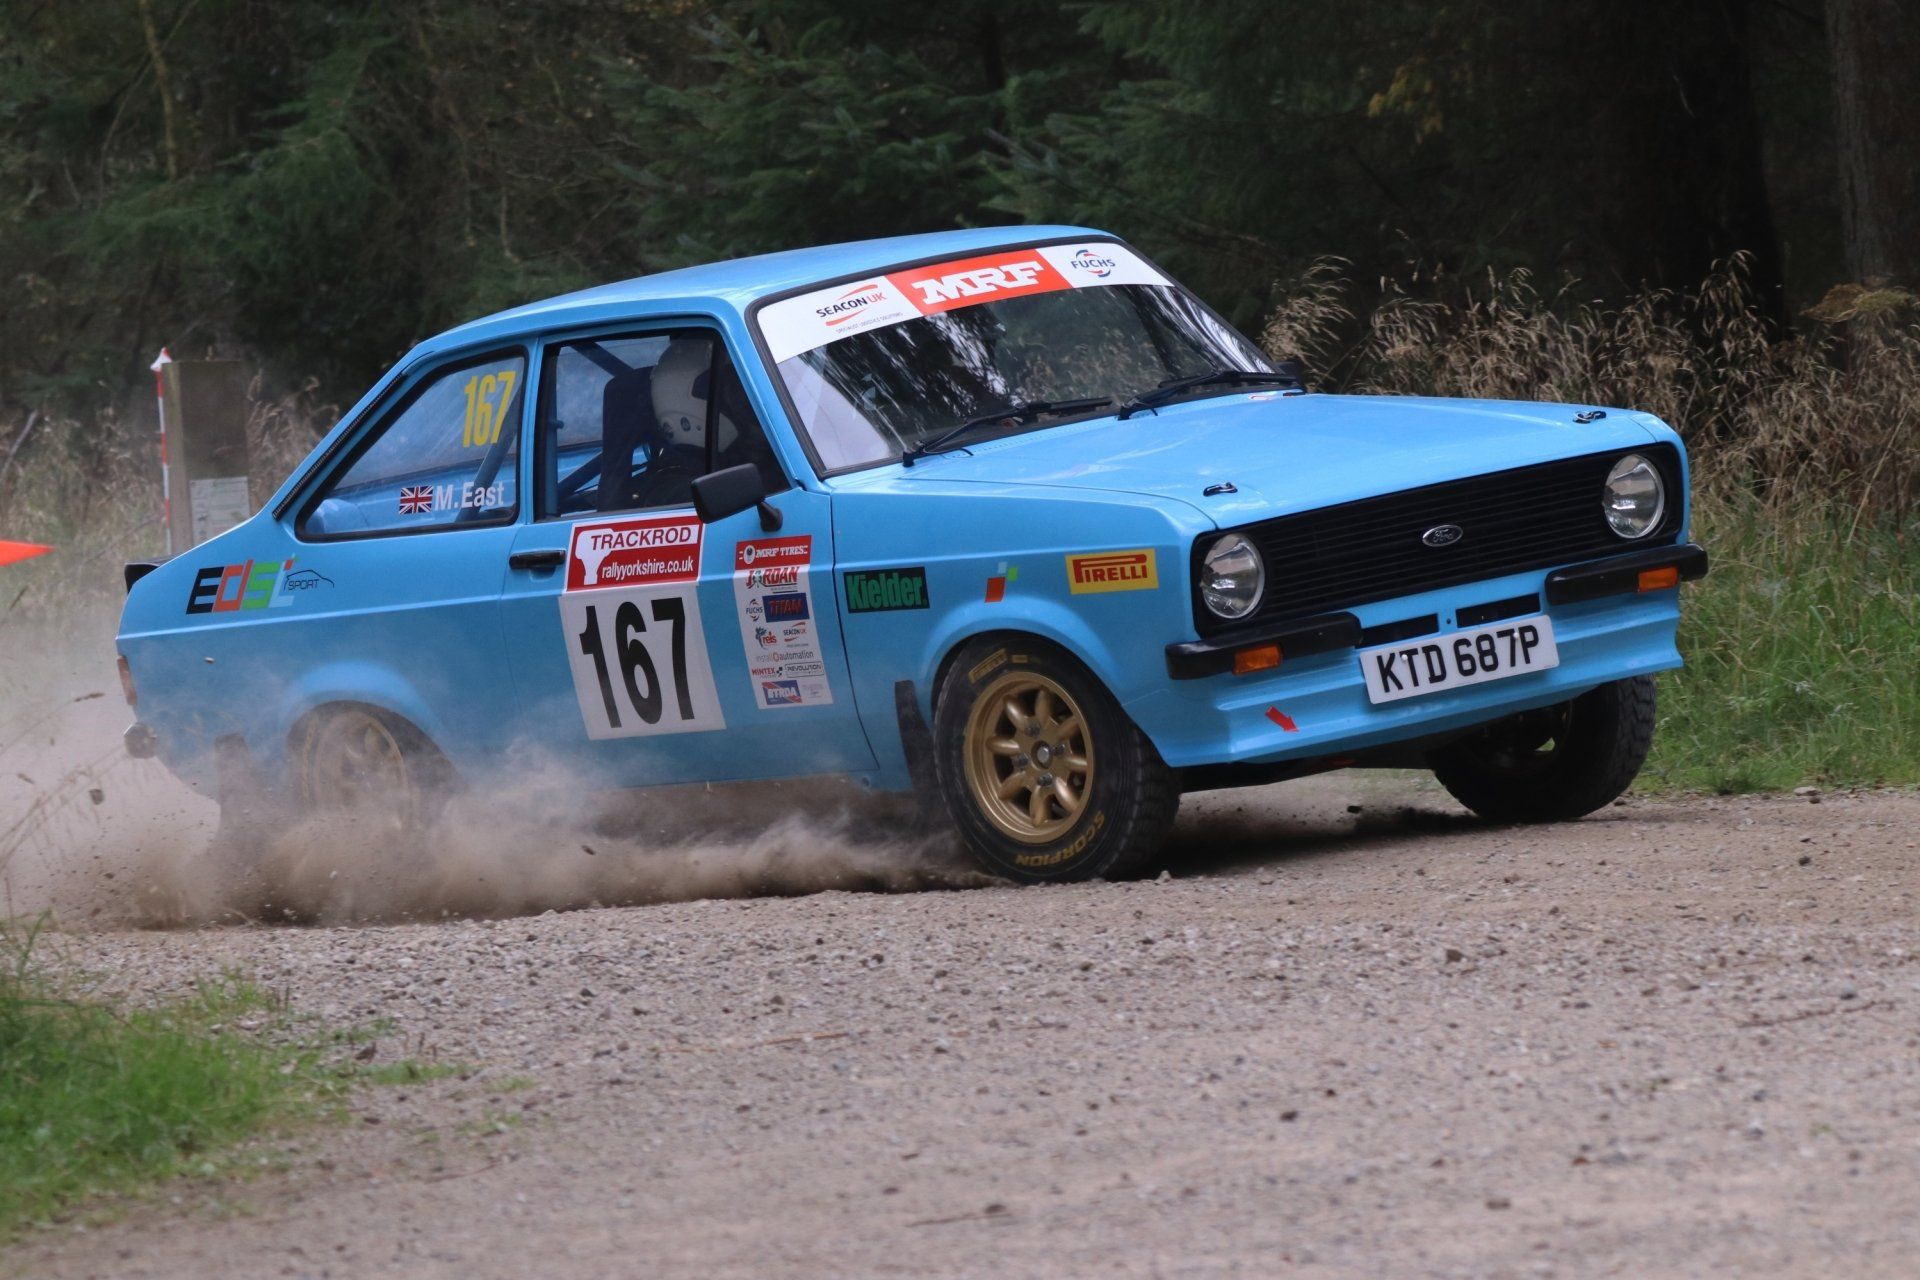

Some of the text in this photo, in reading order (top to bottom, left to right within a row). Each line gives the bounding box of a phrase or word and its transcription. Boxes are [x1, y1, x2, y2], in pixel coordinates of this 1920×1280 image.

[1070, 259, 1116, 269] FUCHS
[911, 260, 1044, 305] MRF
[816, 297, 868, 318] SEACON
[463, 371, 516, 448] 167
[590, 527, 692, 550] TRACKROD
[756, 547, 779, 558] MRF
[602, 556, 694, 581] rallyyorkshire.co.uk
[1072, 554, 1148, 584] PIRELLI
[287, 578, 320, 591] SPORT
[845, 572, 923, 610] Kielder
[579, 597, 695, 728] 167
[1376, 624, 1540, 693] KTD 687P
